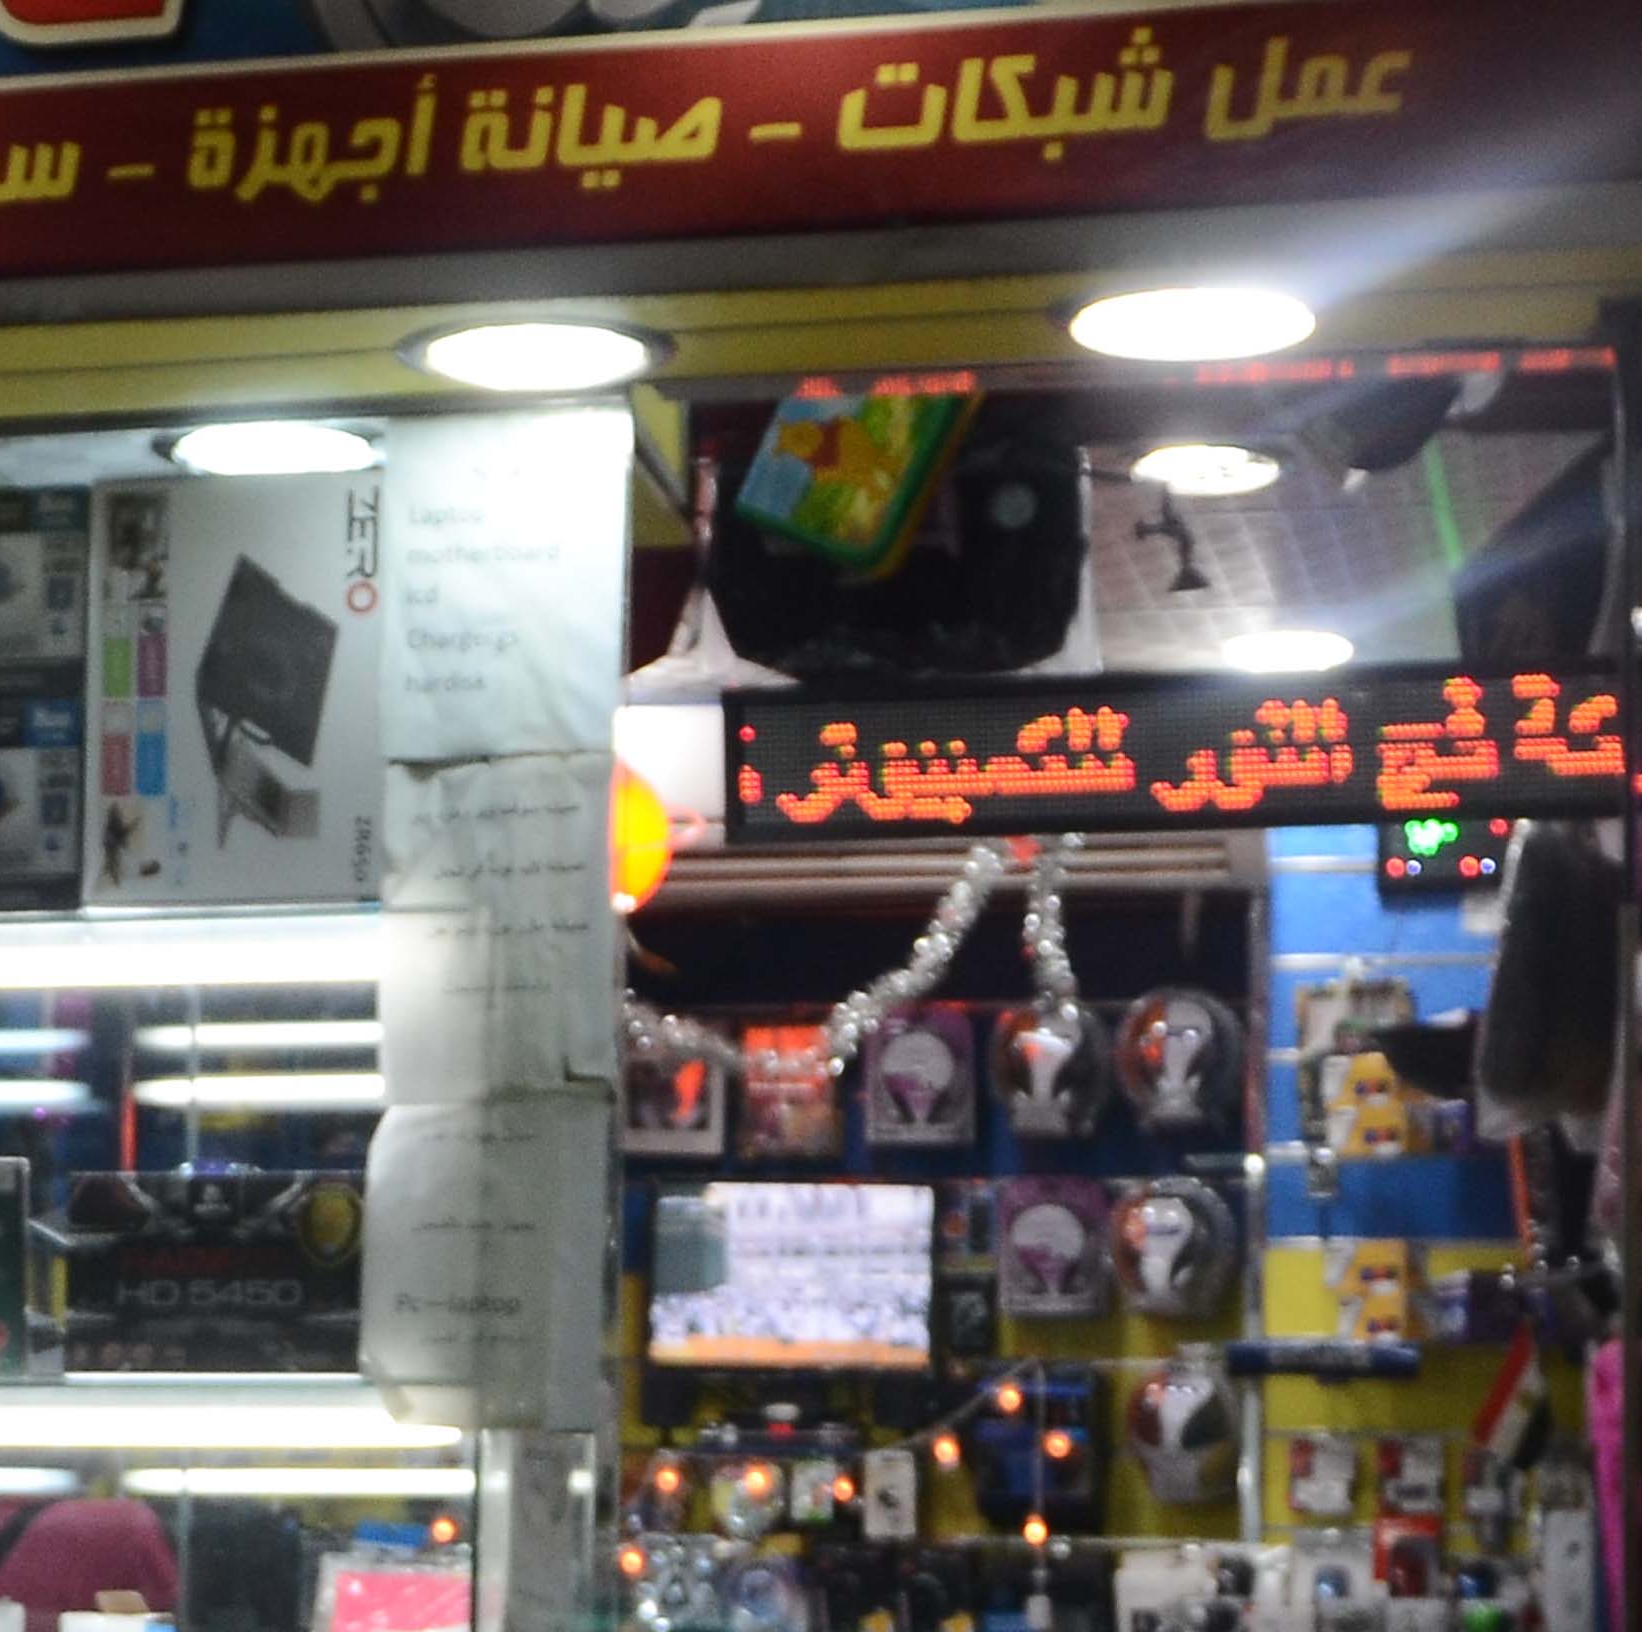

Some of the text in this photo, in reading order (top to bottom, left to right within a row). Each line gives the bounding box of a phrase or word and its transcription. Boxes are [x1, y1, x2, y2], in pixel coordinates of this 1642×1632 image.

[185, 72, 438, 204] أجهزة
[459, 82, 723, 190] صيانة
[835, 25, 1175, 162] شبكات
[1202, 34, 1413, 143] عمل
[345, 485, 379, 615] ZERO
[186, 1279, 303, 1307] 5450
